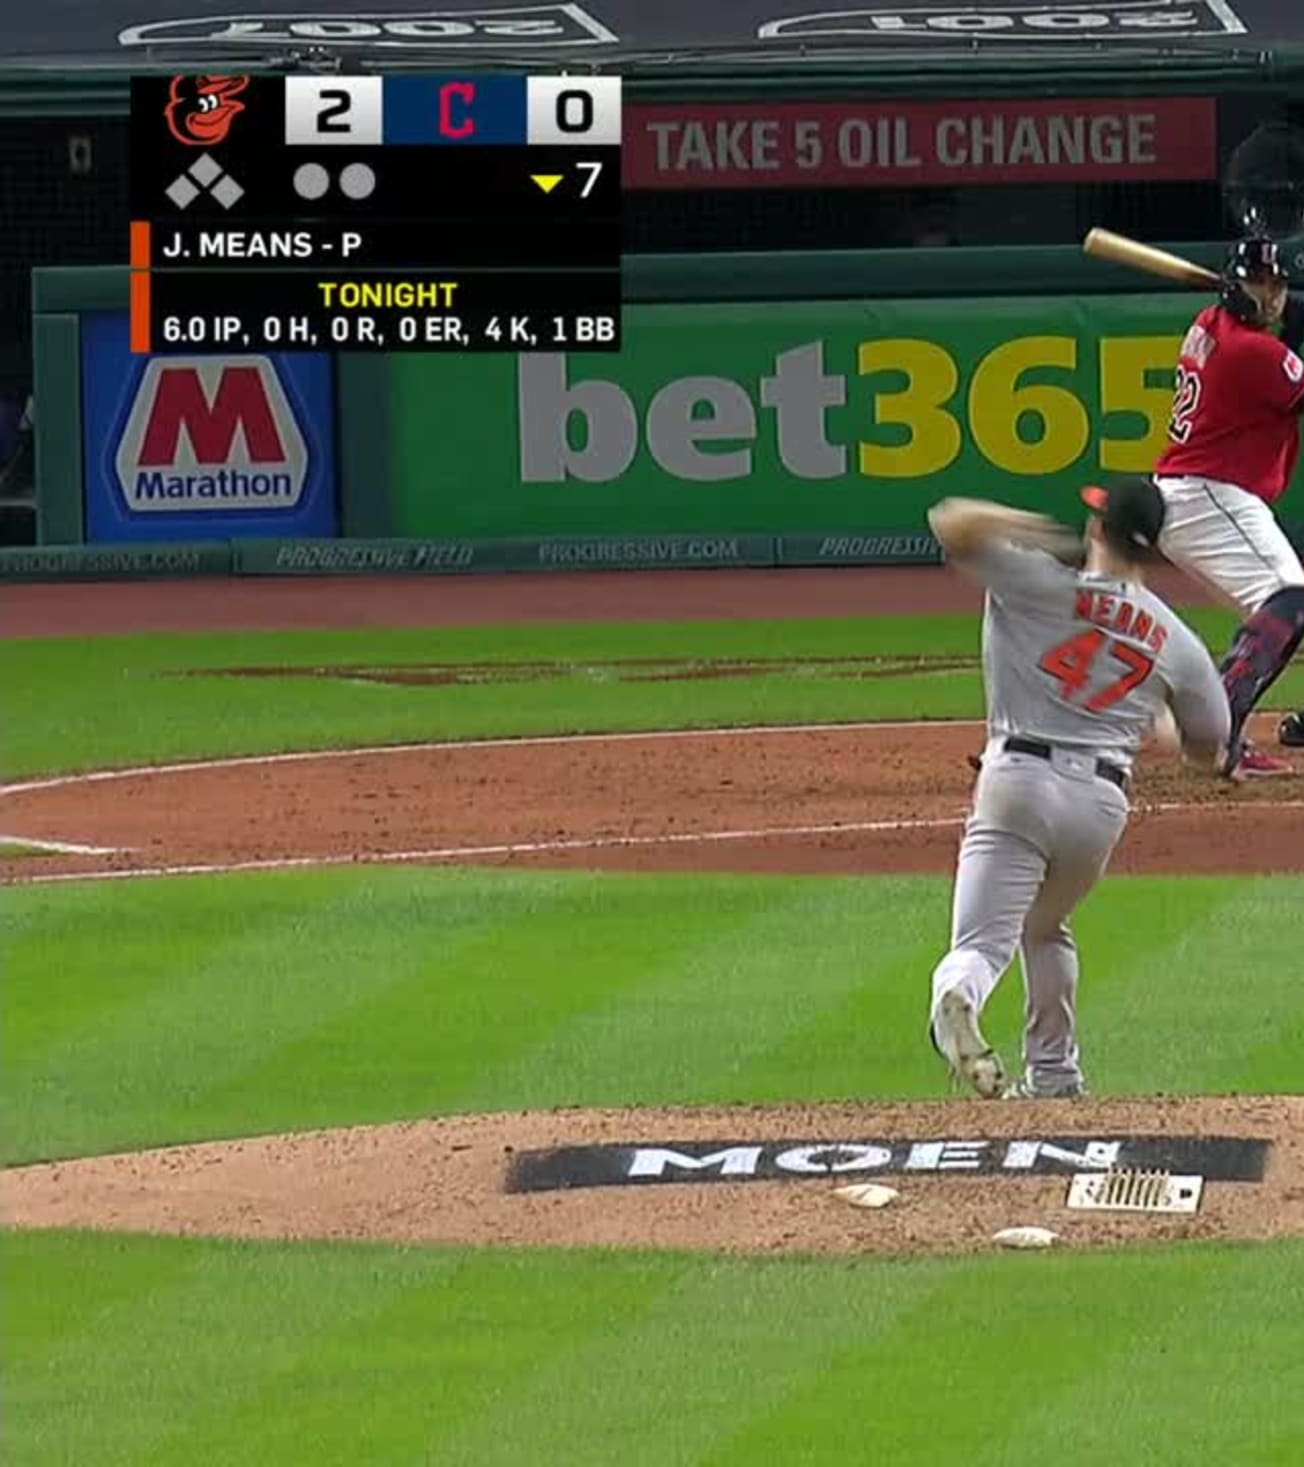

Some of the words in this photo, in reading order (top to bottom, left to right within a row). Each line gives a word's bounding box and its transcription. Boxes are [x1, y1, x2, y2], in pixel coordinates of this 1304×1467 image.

[211, 19, 565, 38] 2007
[871, 7, 1198, 31] 2001
[647, 120, 779, 170] TAKE
[796, 120, 821, 167] 5
[838, 119, 921, 169] OIL
[936, 114, 1157, 166] CHANGE
[519, 335, 1181, 483] bet365
[135, 469, 292, 501] Marathon
[538, 538, 738, 562] PROGRESSIVE.COM
[1074, 588, 1169, 653] MEANS
[1040, 627, 1155, 713] 47
[628, 1140, 1121, 1178] MOEN
